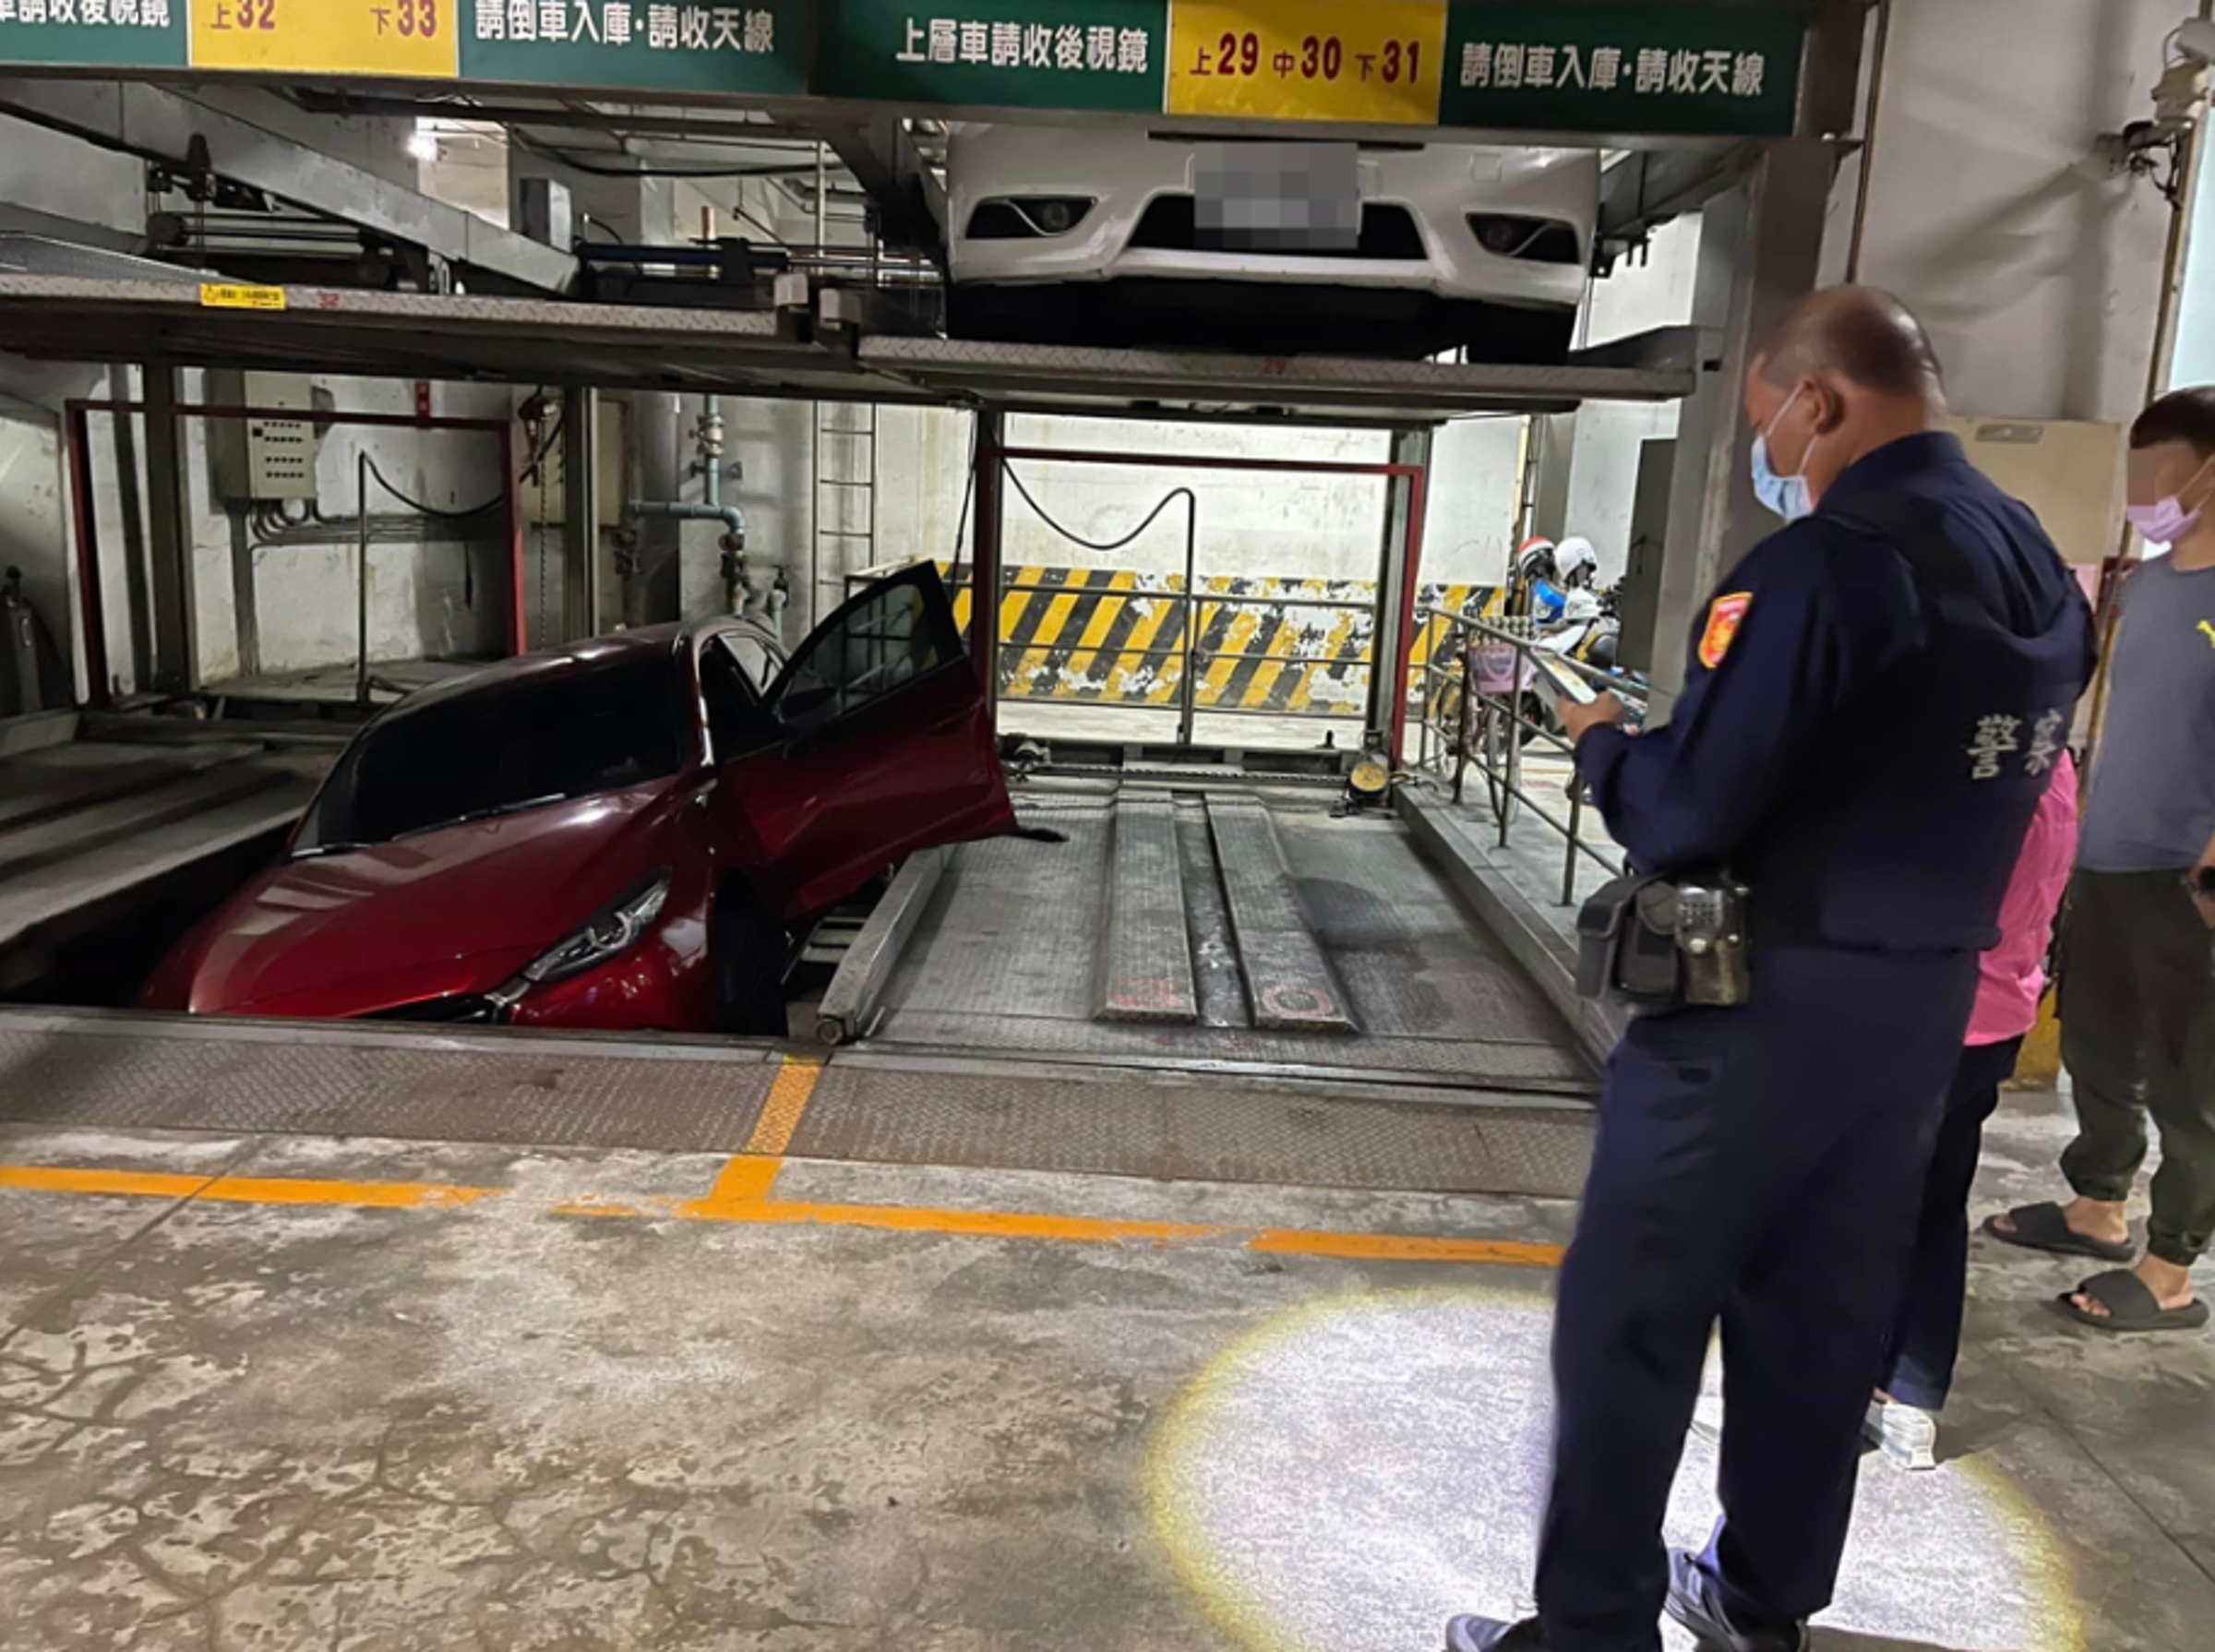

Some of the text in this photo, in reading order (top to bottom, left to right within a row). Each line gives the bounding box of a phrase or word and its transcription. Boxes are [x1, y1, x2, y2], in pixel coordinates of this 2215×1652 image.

[895, 17, 1148, 73] 上層車請收後視鏡
[1967, 708, 2063, 779] 警察
